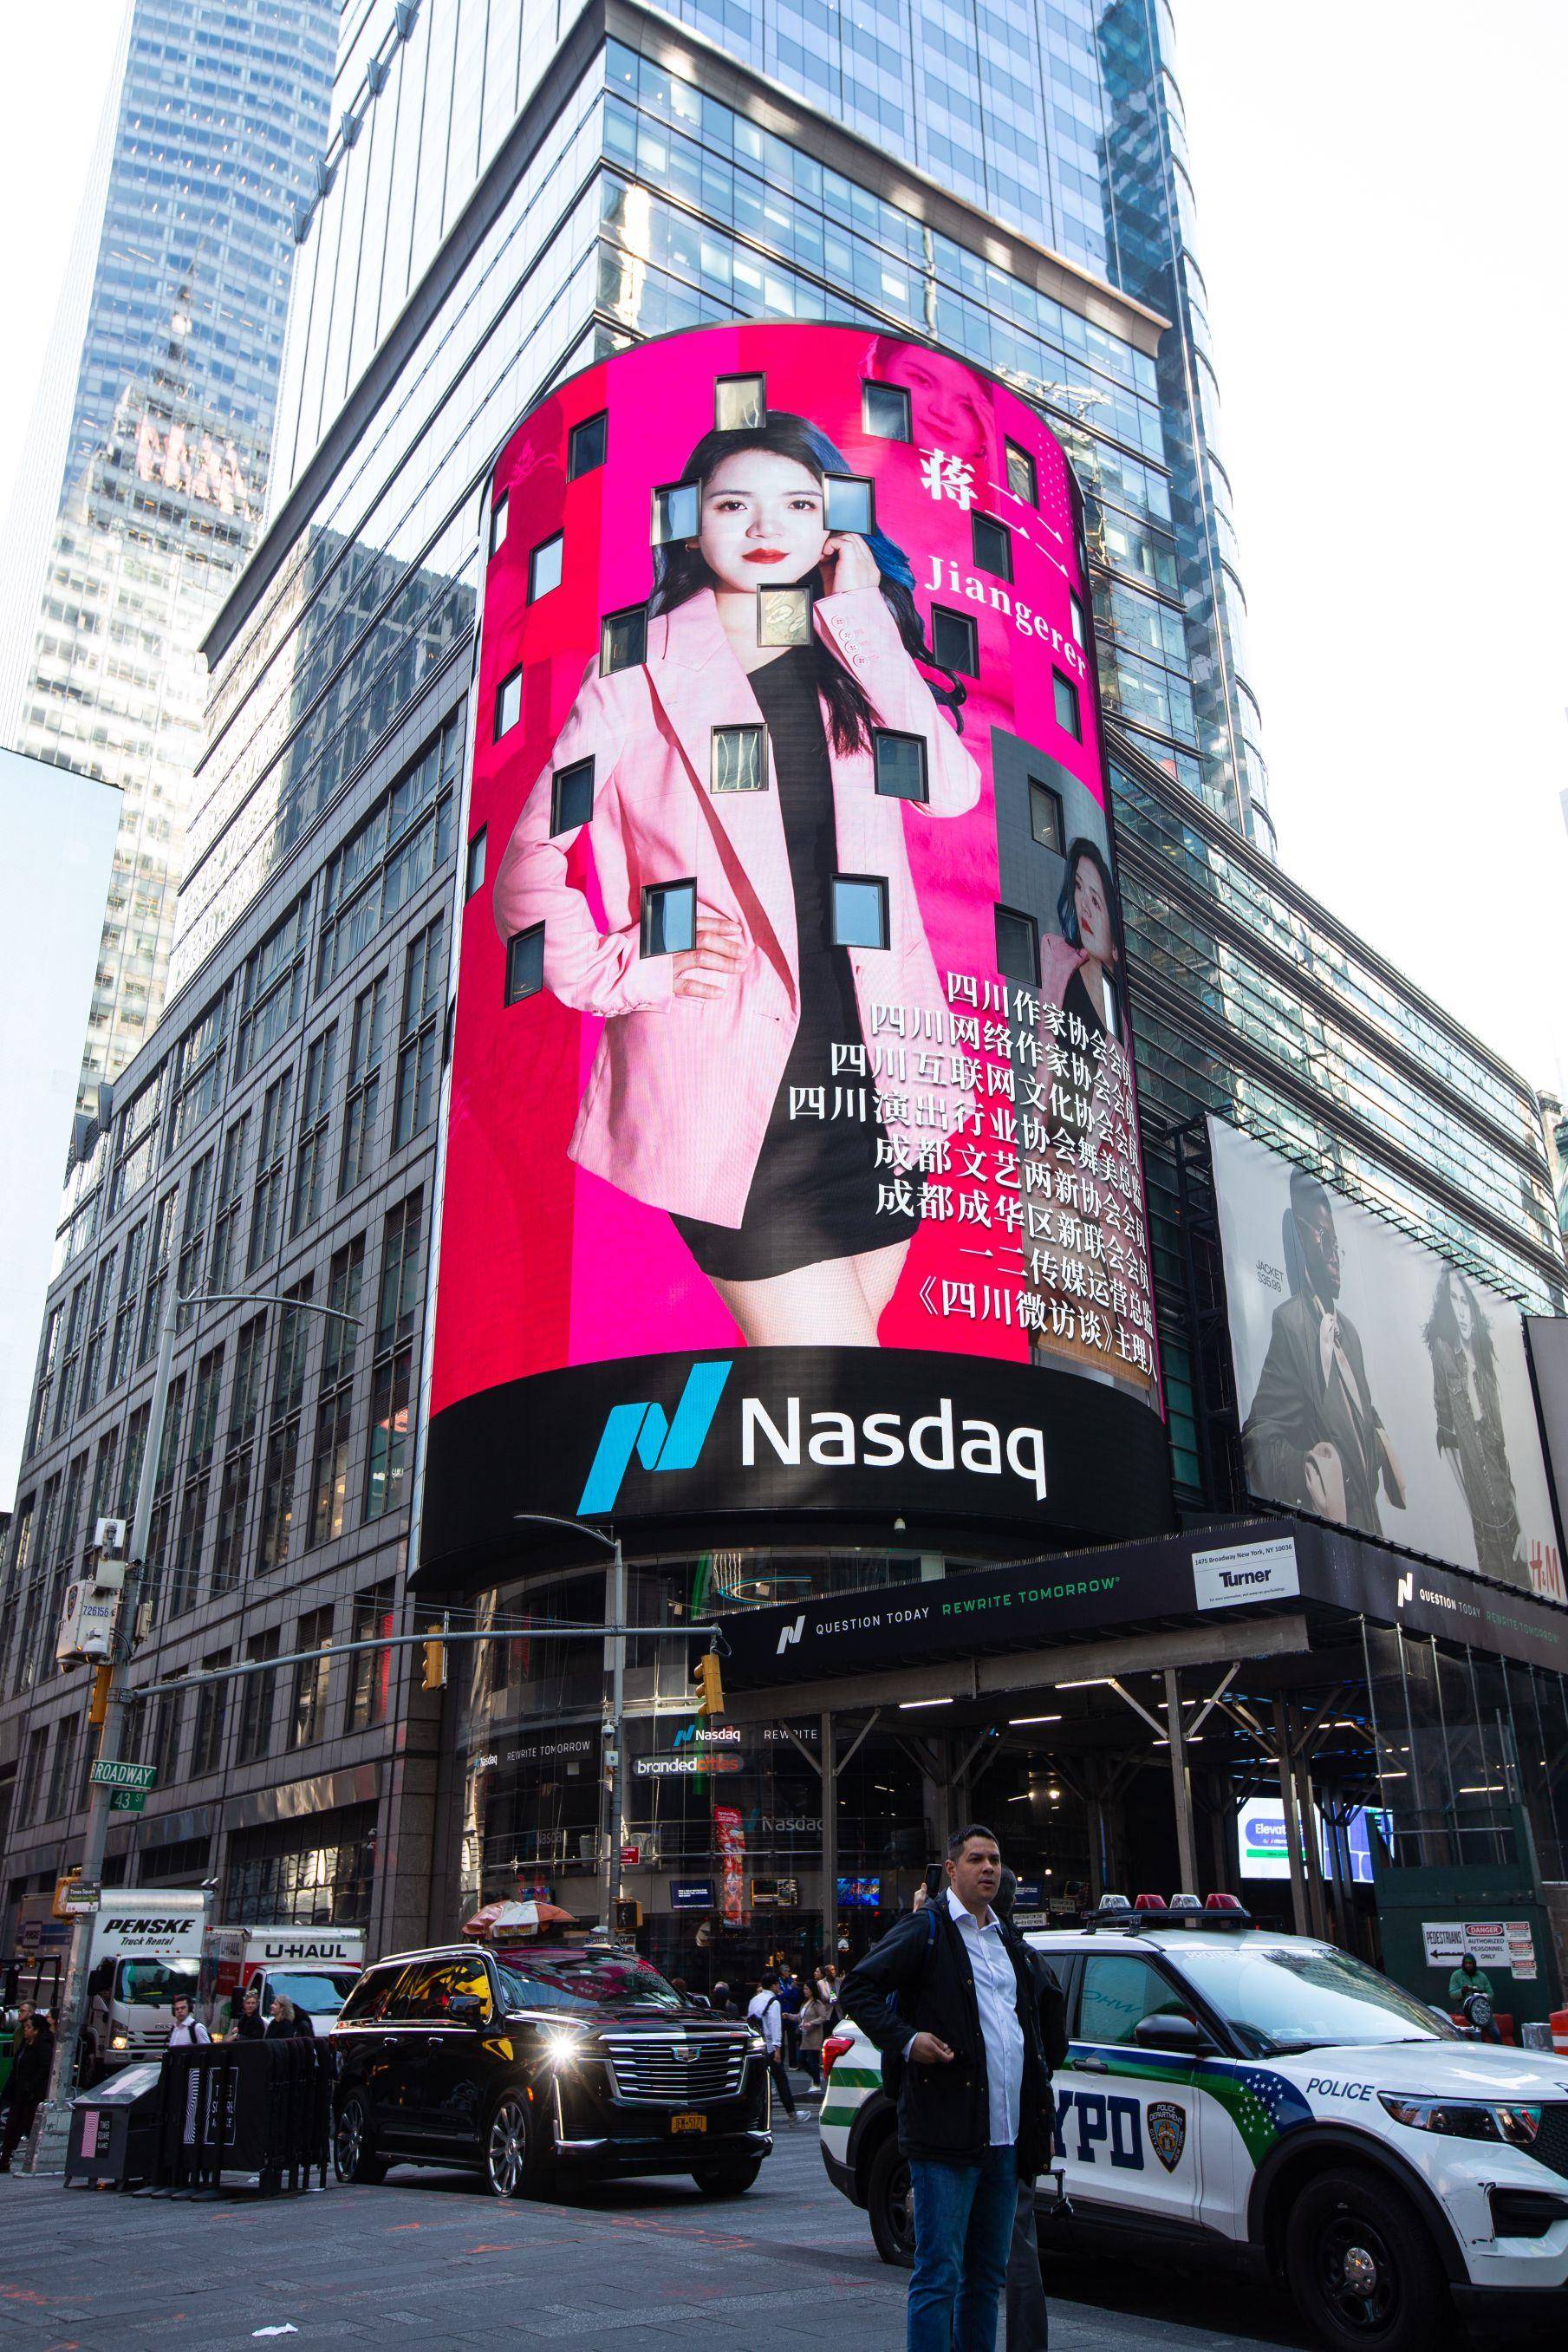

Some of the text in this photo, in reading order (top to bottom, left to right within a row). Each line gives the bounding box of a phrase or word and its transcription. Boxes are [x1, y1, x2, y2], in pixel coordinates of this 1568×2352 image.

[924, 555, 1086, 681] Jiangerer
[947, 970, 1133, 1095] 四川作家协会会员
[872, 1003, 1136, 1134] 四川网络作家协会会员
[831, 1043, 1140, 1174] 四川互联网文化协会会员
[790, 1085, 1143, 1214] 四川演出行业协会舞美总监
[874, 1133, 1147, 1255] 成都文艺两新协会会员
[875, 1178, 1150, 1298] 成都成华区新联会会员
[1256, 1260, 1283, 1282] JACKET
[1257, 1271, 1282, 1293] $35.99
[960, 1245, 1155, 1340] 一二传媒运营总监
[919, 1275, 1158, 1383] 《四川微访谈》主理人
[742, 1397, 1046, 1501] Nasdaq
[1209, 1554, 1236, 1564] Broadway
[1530, 1539, 1561, 1599] H&M
[1219, 1568, 1272, 1587] Turner
[83, 1606, 109, 1617] 726156
[816, 1615, 881, 1635] QUESTION
[887, 1607, 929, 1624] TODAY
[942, 1593, 1012, 1615] REWRITE
[1419, 1588, 1456, 1611] QUESTION
[1459, 1601, 1480, 1619] TODAY
[1487, 1611, 1518, 1630] REWRITE
[695, 1730, 741, 1743] Nasdaq
[480, 1754, 498, 1767] Nasdaq
[507, 1741, 590, 1762] REWRITE TOMORROW
[90, 1762, 153, 1785] BROADWAY
[637, 1754, 738, 1774] brandedcities
[114, 1791, 144, 1808] 43 ST
[102, 1919, 195, 1933] PENSKE
[120, 1937, 174, 1945] Truck Rental
[1426, 1932, 1462, 1944] PEDESTRIANS
[265, 1945, 347, 1958] U-HAUL
[1305, 2077, 1375, 2101] POLICE
[1149, 2111, 1183, 2126] DEPARTMENT
[1156, 2104, 1176, 2114] POLICE
[1054, 2089, 1144, 2171] YPD
